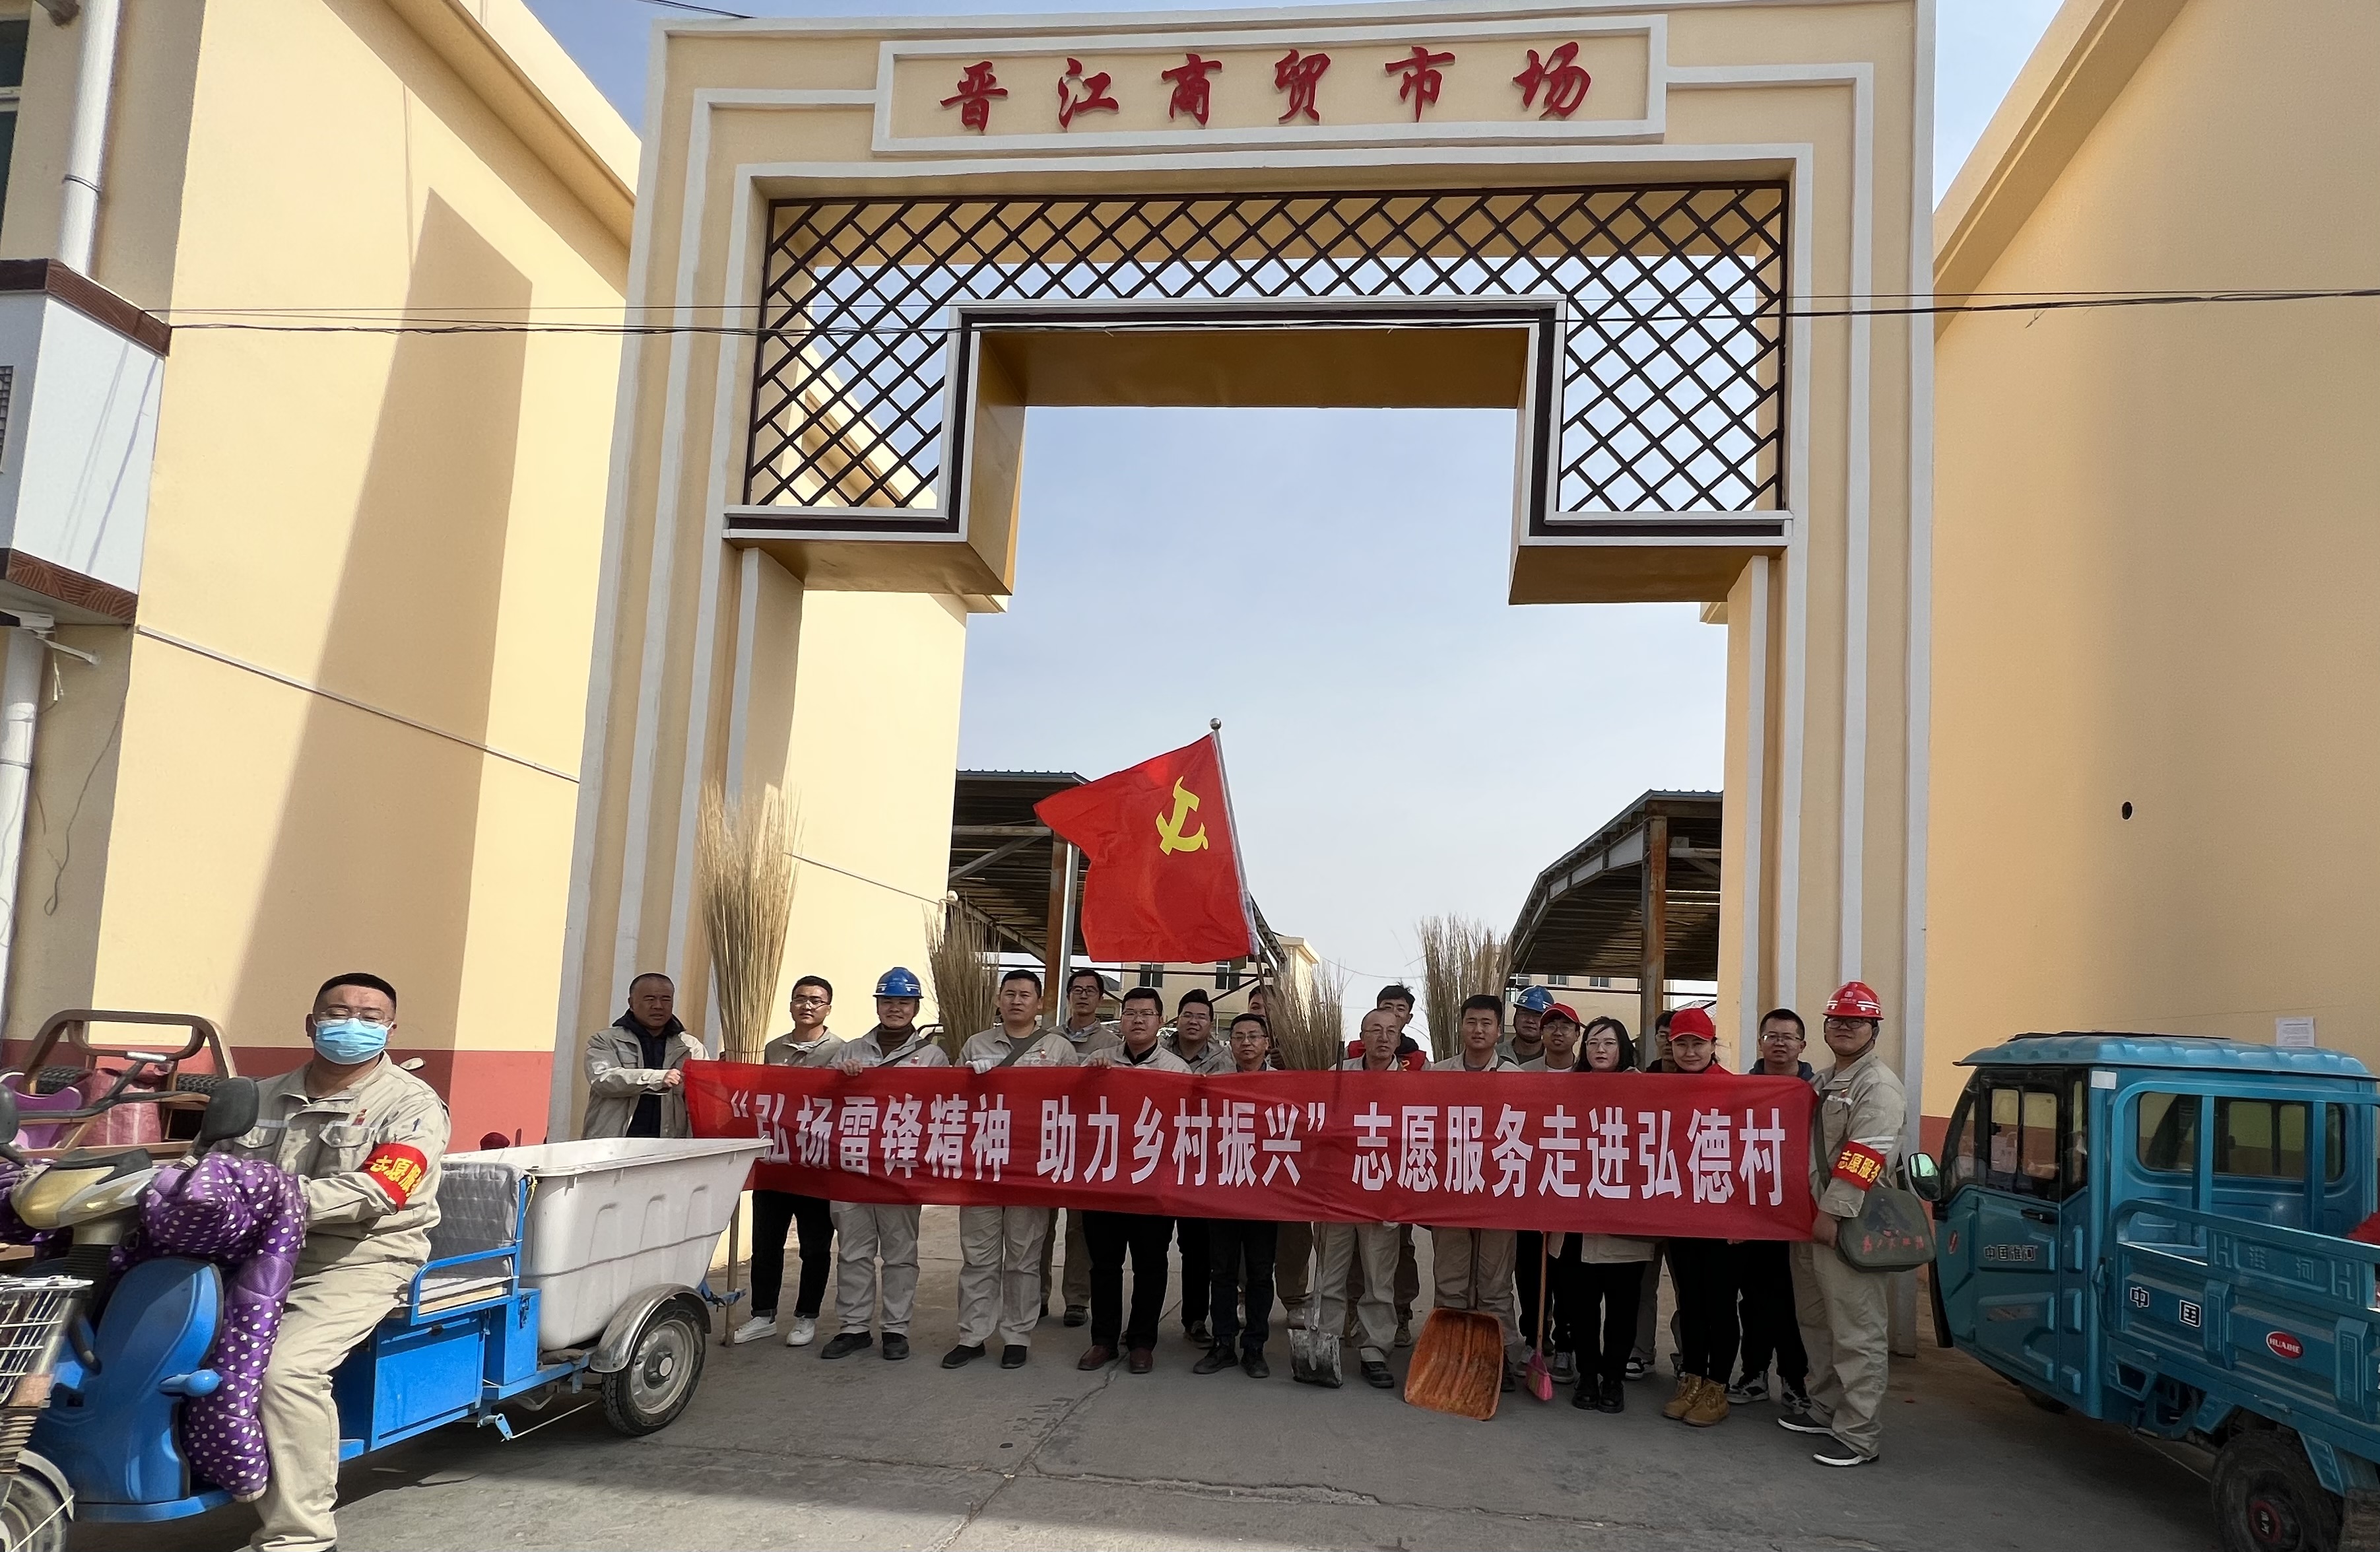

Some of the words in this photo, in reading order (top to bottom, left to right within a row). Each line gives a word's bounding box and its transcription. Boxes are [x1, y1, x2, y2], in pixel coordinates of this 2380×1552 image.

[941, 41, 1591, 136] 晋江商贸市场
[1036, 1095, 1326, 1187] 助力乡村振兴”
[1352, 1101, 1785, 1207] 志愿服务走进弘德村
[1983, 1244, 2037, 1262] 中国淮河
[2268, 1337, 2301, 1355] HUAIHE
